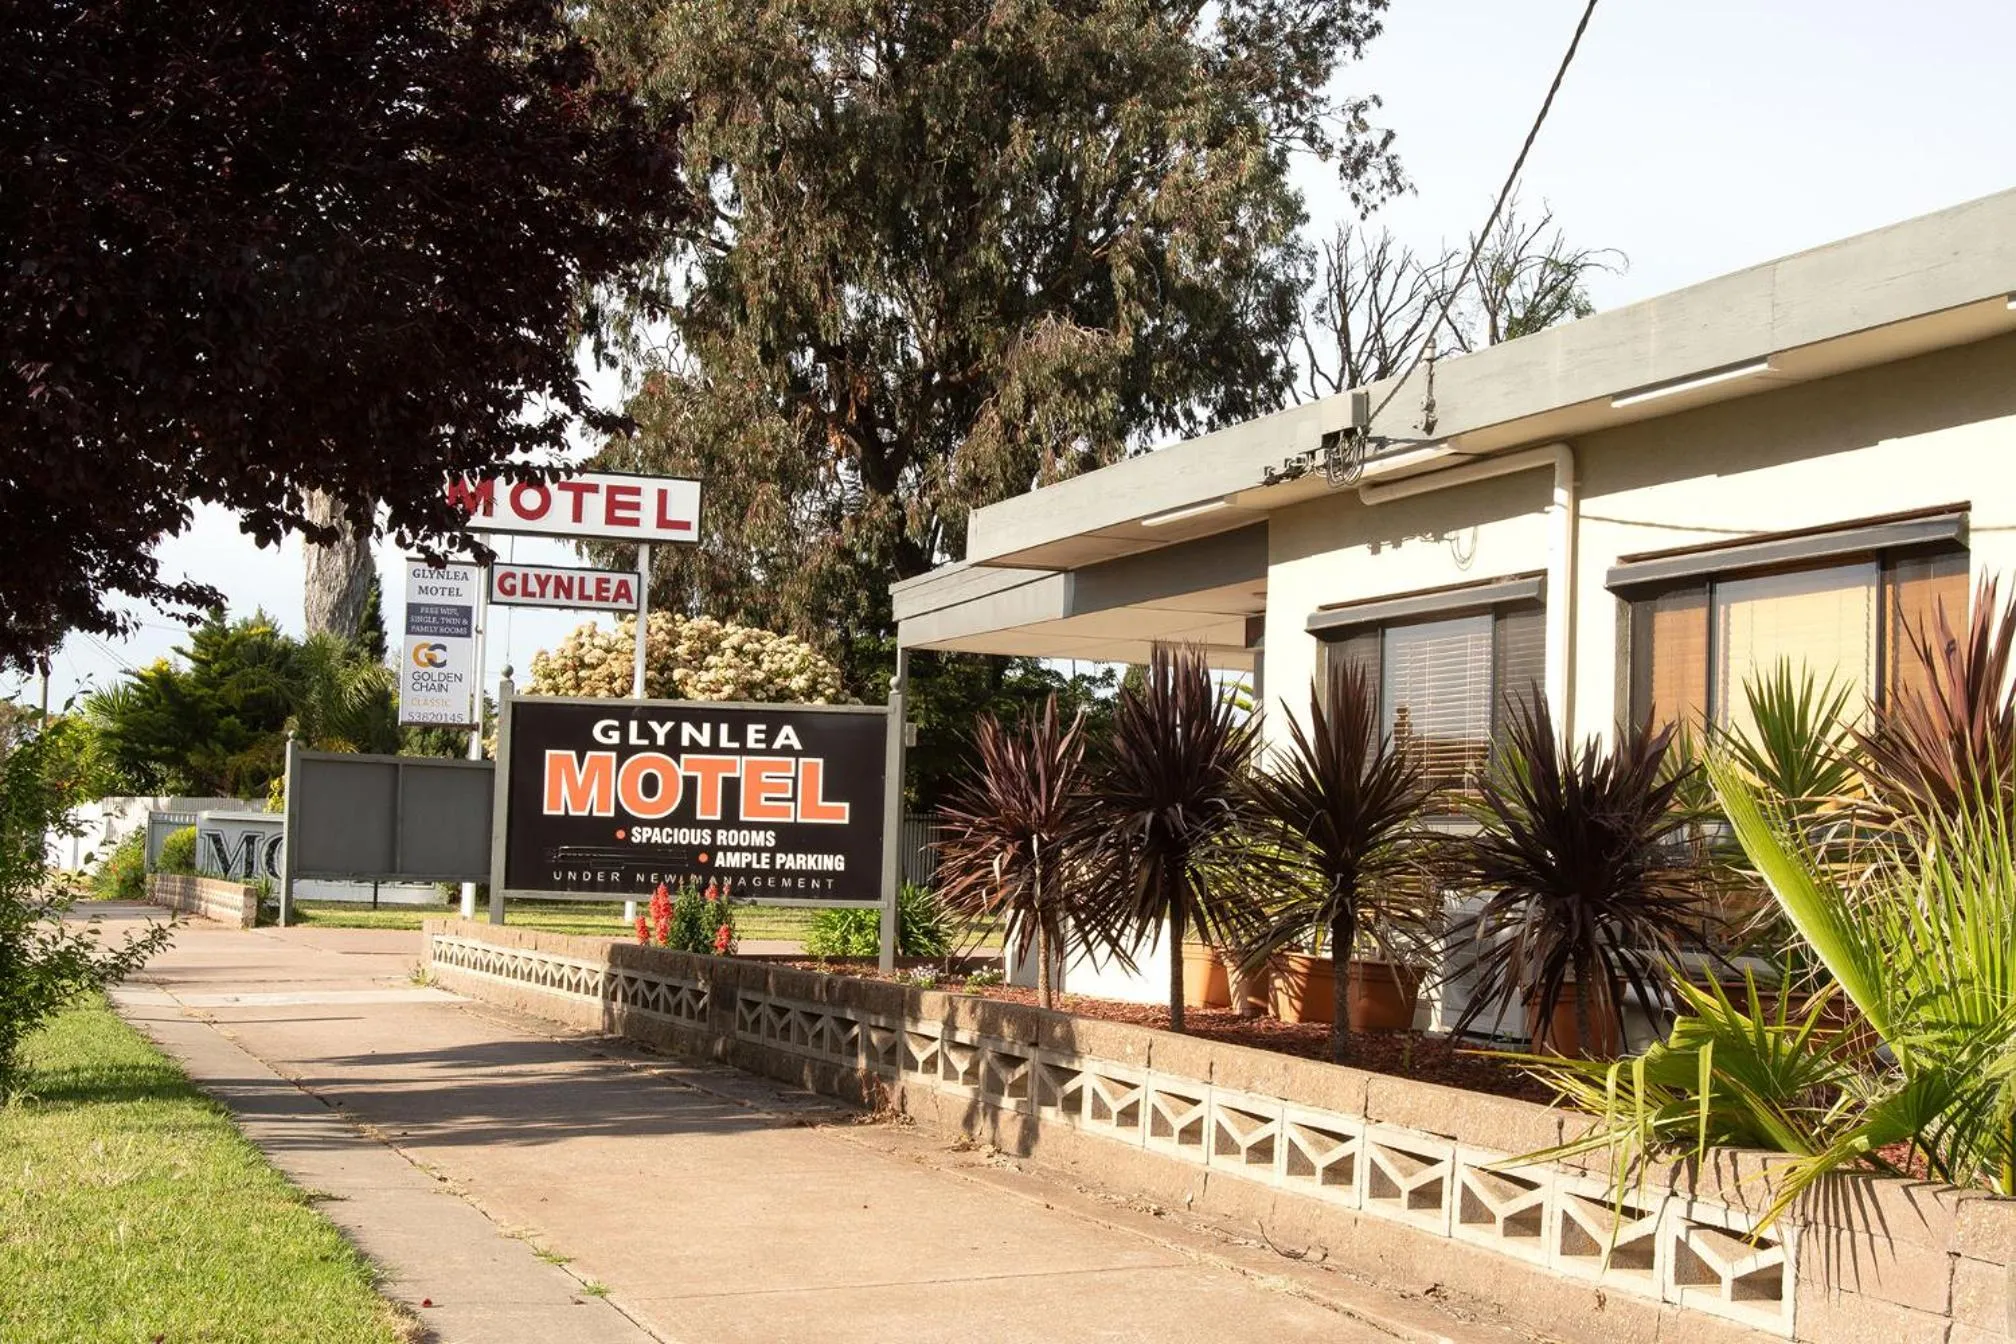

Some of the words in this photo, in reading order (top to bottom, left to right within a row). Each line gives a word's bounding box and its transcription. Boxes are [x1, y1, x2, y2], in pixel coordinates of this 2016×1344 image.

[448, 476, 692, 531] MOTEL
[412, 568, 470, 581] GLYNLEA
[418, 585, 464, 597] MOTEL
[497, 571, 634, 604] GLYNLEA
[410, 625, 439, 633] FAMILY
[440, 627, 467, 635] ROOMS
[411, 671, 464, 682] GOLDEN
[411, 682, 449, 692] CHAIN
[592, 719, 803, 750] GLYNLEA
[543, 749, 850, 824] MOTEL
[631, 827, 712, 845] SPACIOUS
[716, 830, 776, 847] ROOMS
[714, 852, 771, 869] AMPLE
[775, 854, 845, 871] PARKING
[553, 871, 620, 881] UNDER
[636, 873, 677, 883] NEW
[690, 873, 834, 889] MANAGEMENT
